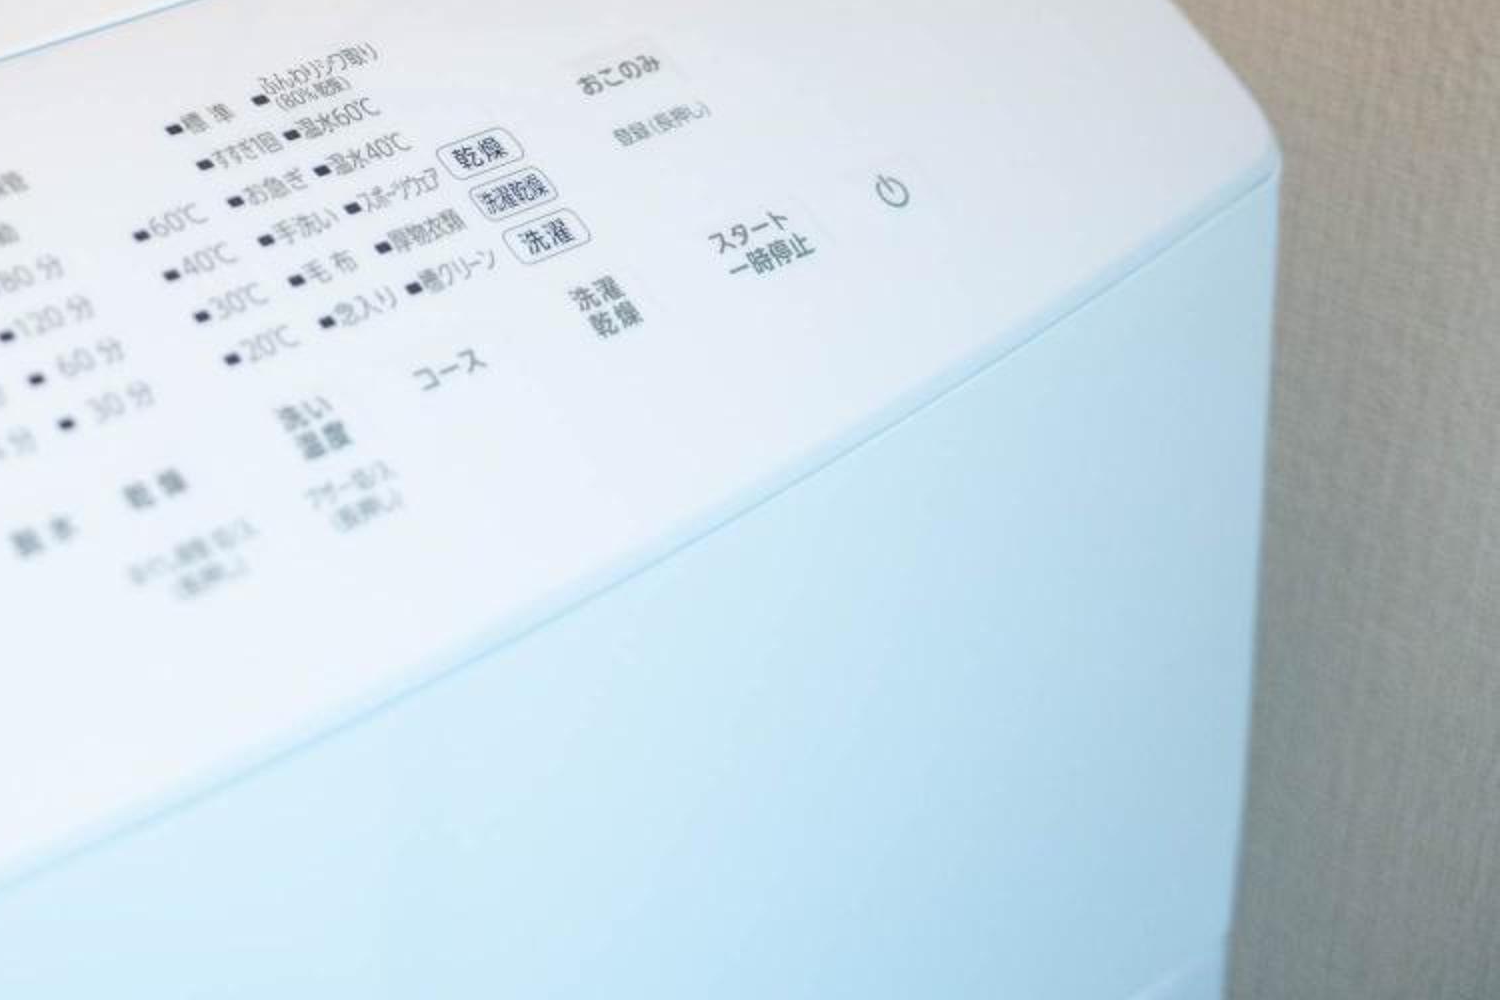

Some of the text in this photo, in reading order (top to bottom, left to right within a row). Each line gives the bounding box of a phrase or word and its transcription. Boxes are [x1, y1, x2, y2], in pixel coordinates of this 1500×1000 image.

[577, 54, 661, 96] おこのみ
[451, 136, 510, 171] 乾燥
[481, 173, 551, 216] 洗濯乾燥
[274, 208, 340, 246] 手洗い
[517, 217, 576, 257] 洗濯
[706, 209, 790, 256] スタート
[728, 231, 817, 279] 一時停止
[569, 274, 628, 312] 洗濯
[588, 299, 645, 339] 乾燥
[412, 348, 487, 392] コース
